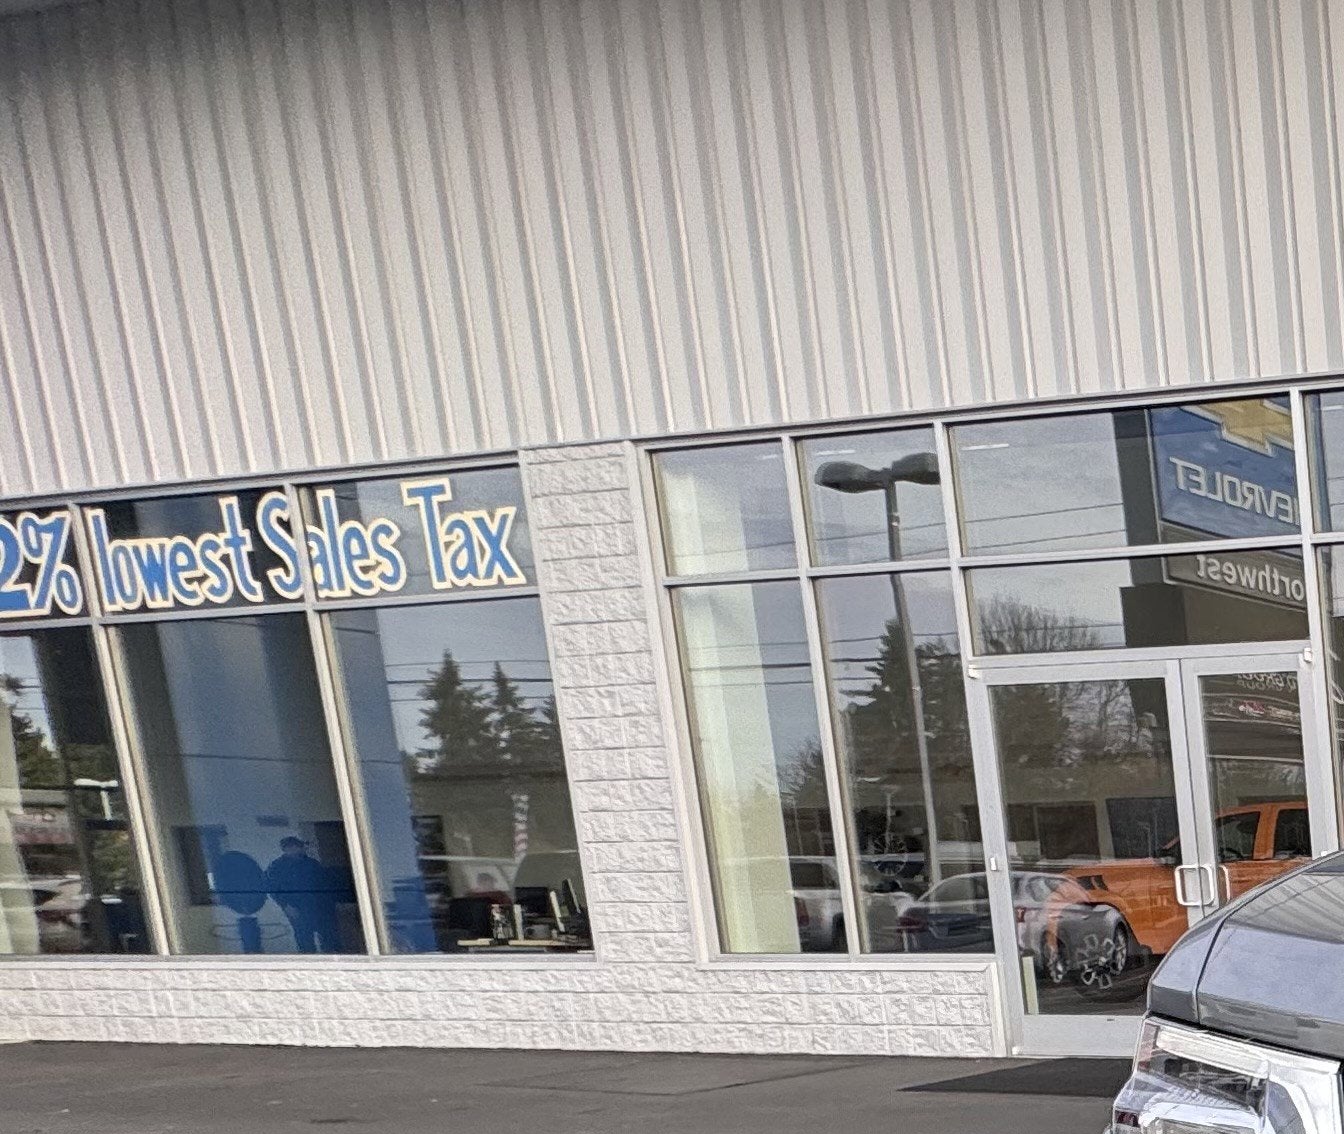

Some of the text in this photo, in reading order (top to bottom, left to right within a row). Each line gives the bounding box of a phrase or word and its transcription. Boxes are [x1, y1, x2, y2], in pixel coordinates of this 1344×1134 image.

[85, 496, 263, 613] lowest
[256, 489, 406, 602] Sales
[402, 477, 528, 590] Tax
